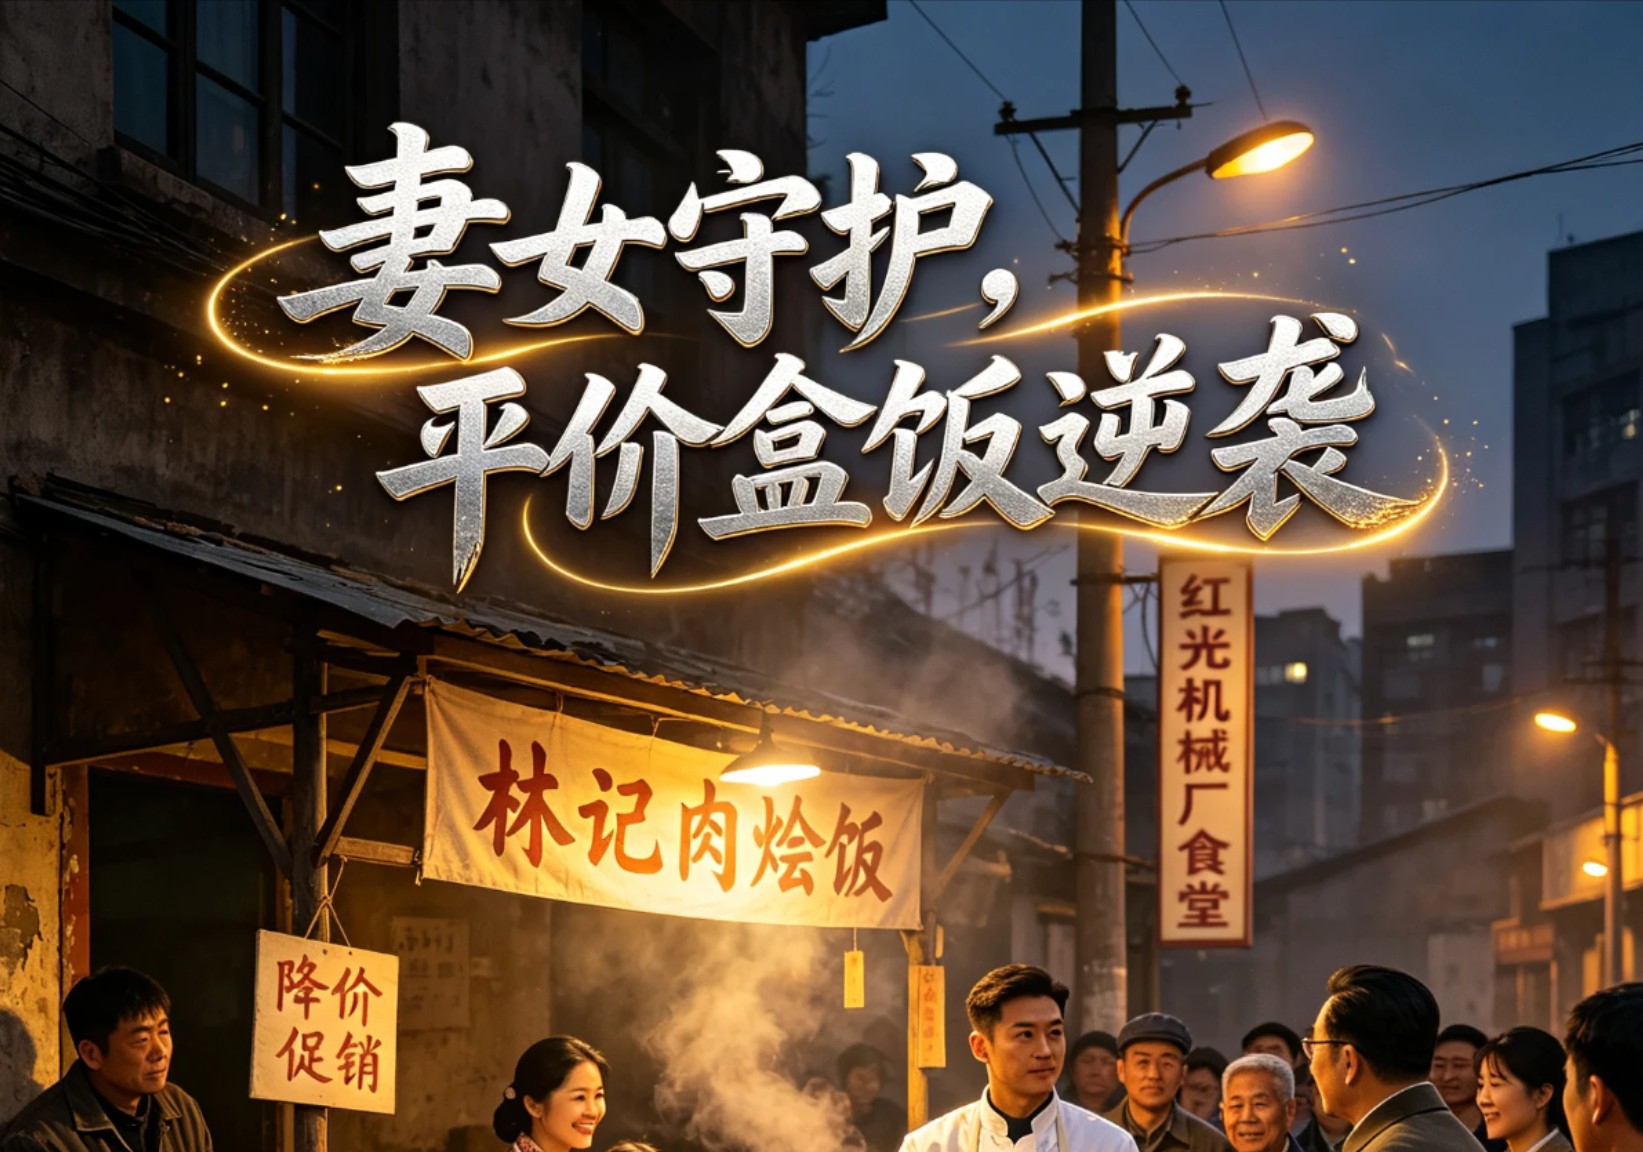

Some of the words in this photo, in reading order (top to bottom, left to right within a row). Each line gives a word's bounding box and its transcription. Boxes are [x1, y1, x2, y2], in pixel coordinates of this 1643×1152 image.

[1176, 573, 1232, 929] 红光机械厂食堂
[473, 739, 894, 903] 林记肉烩饭
[276, 953, 384, 1028] 降价
[275, 1026, 383, 1094] 促销
